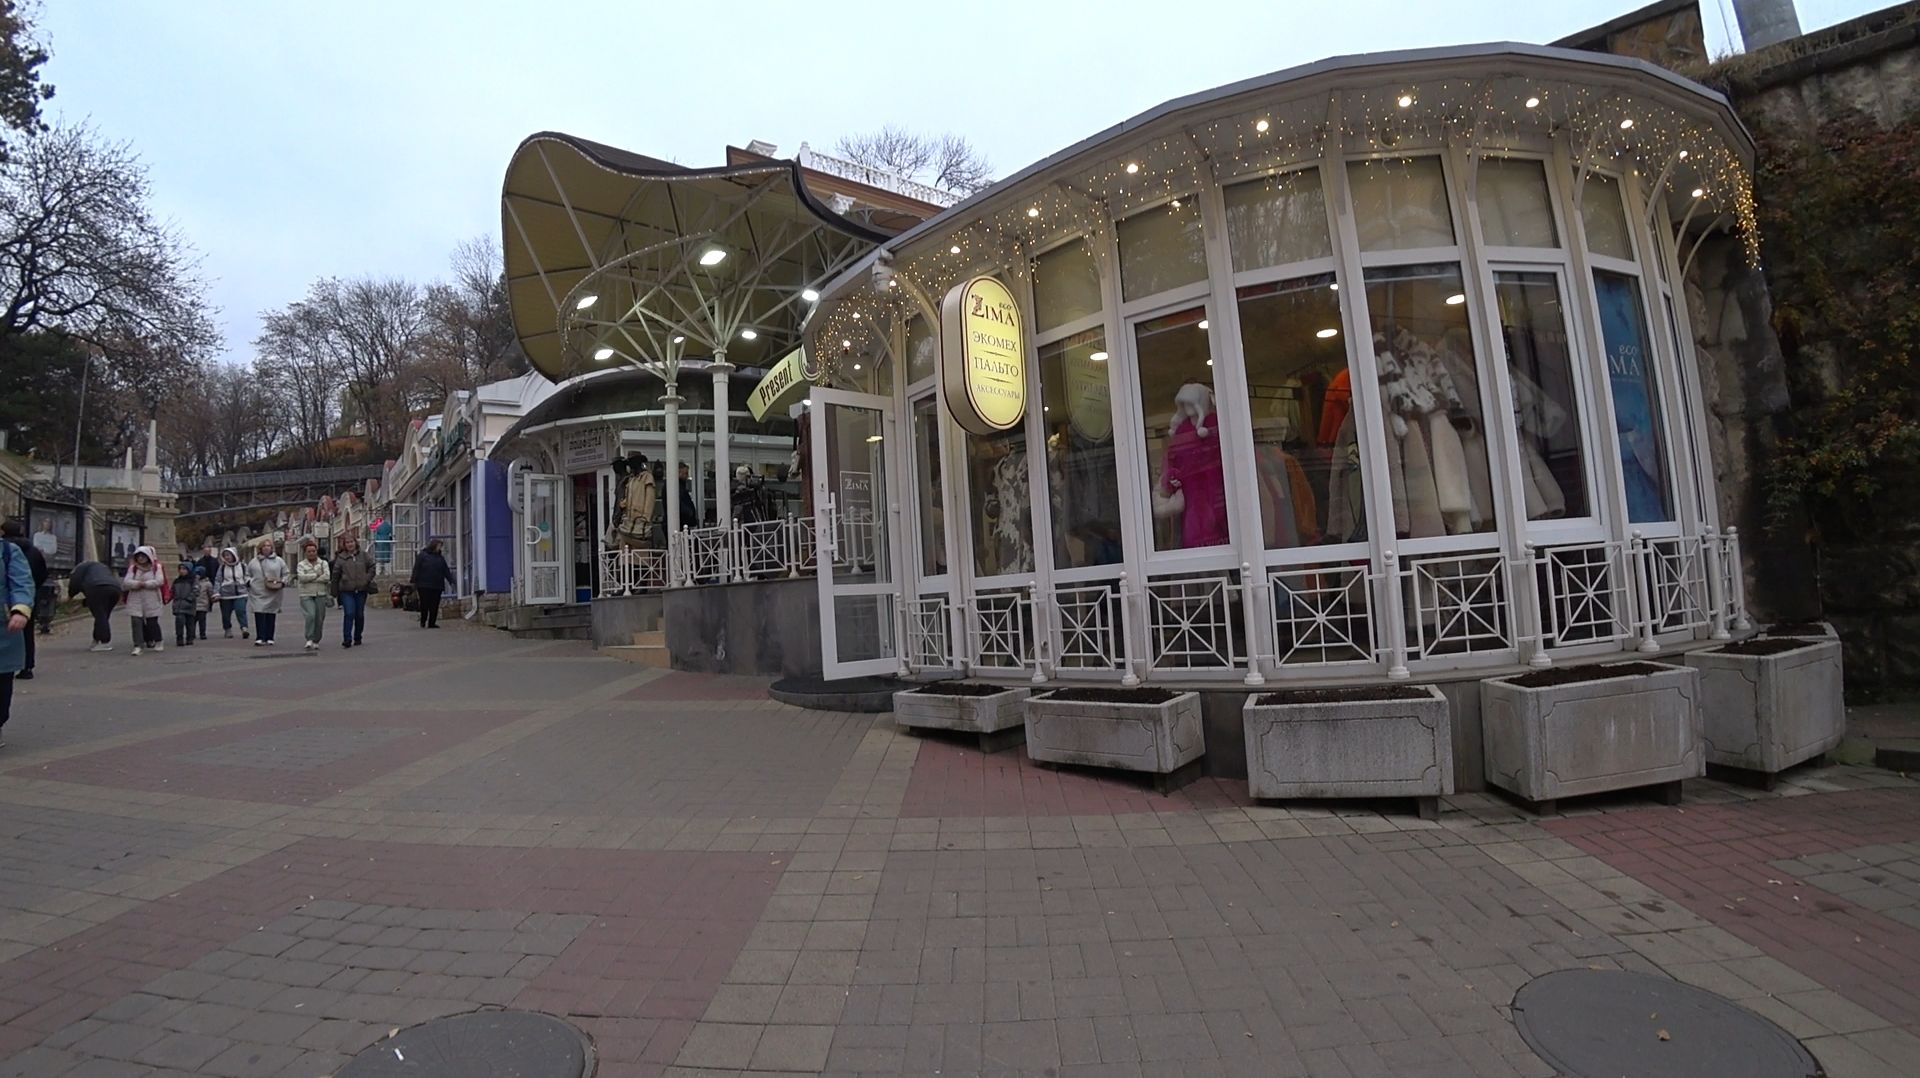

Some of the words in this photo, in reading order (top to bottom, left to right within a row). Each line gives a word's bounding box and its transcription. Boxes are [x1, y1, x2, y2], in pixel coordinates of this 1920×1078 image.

[972, 330, 1017, 352] ЭКОМЕХ
[974, 356, 1019, 378] ПАЛЬТО
[1609, 354, 1640, 377] MA
[759, 360, 793, 407] Present
[975, 384, 1021, 400] АКСЕССУАРЫ
